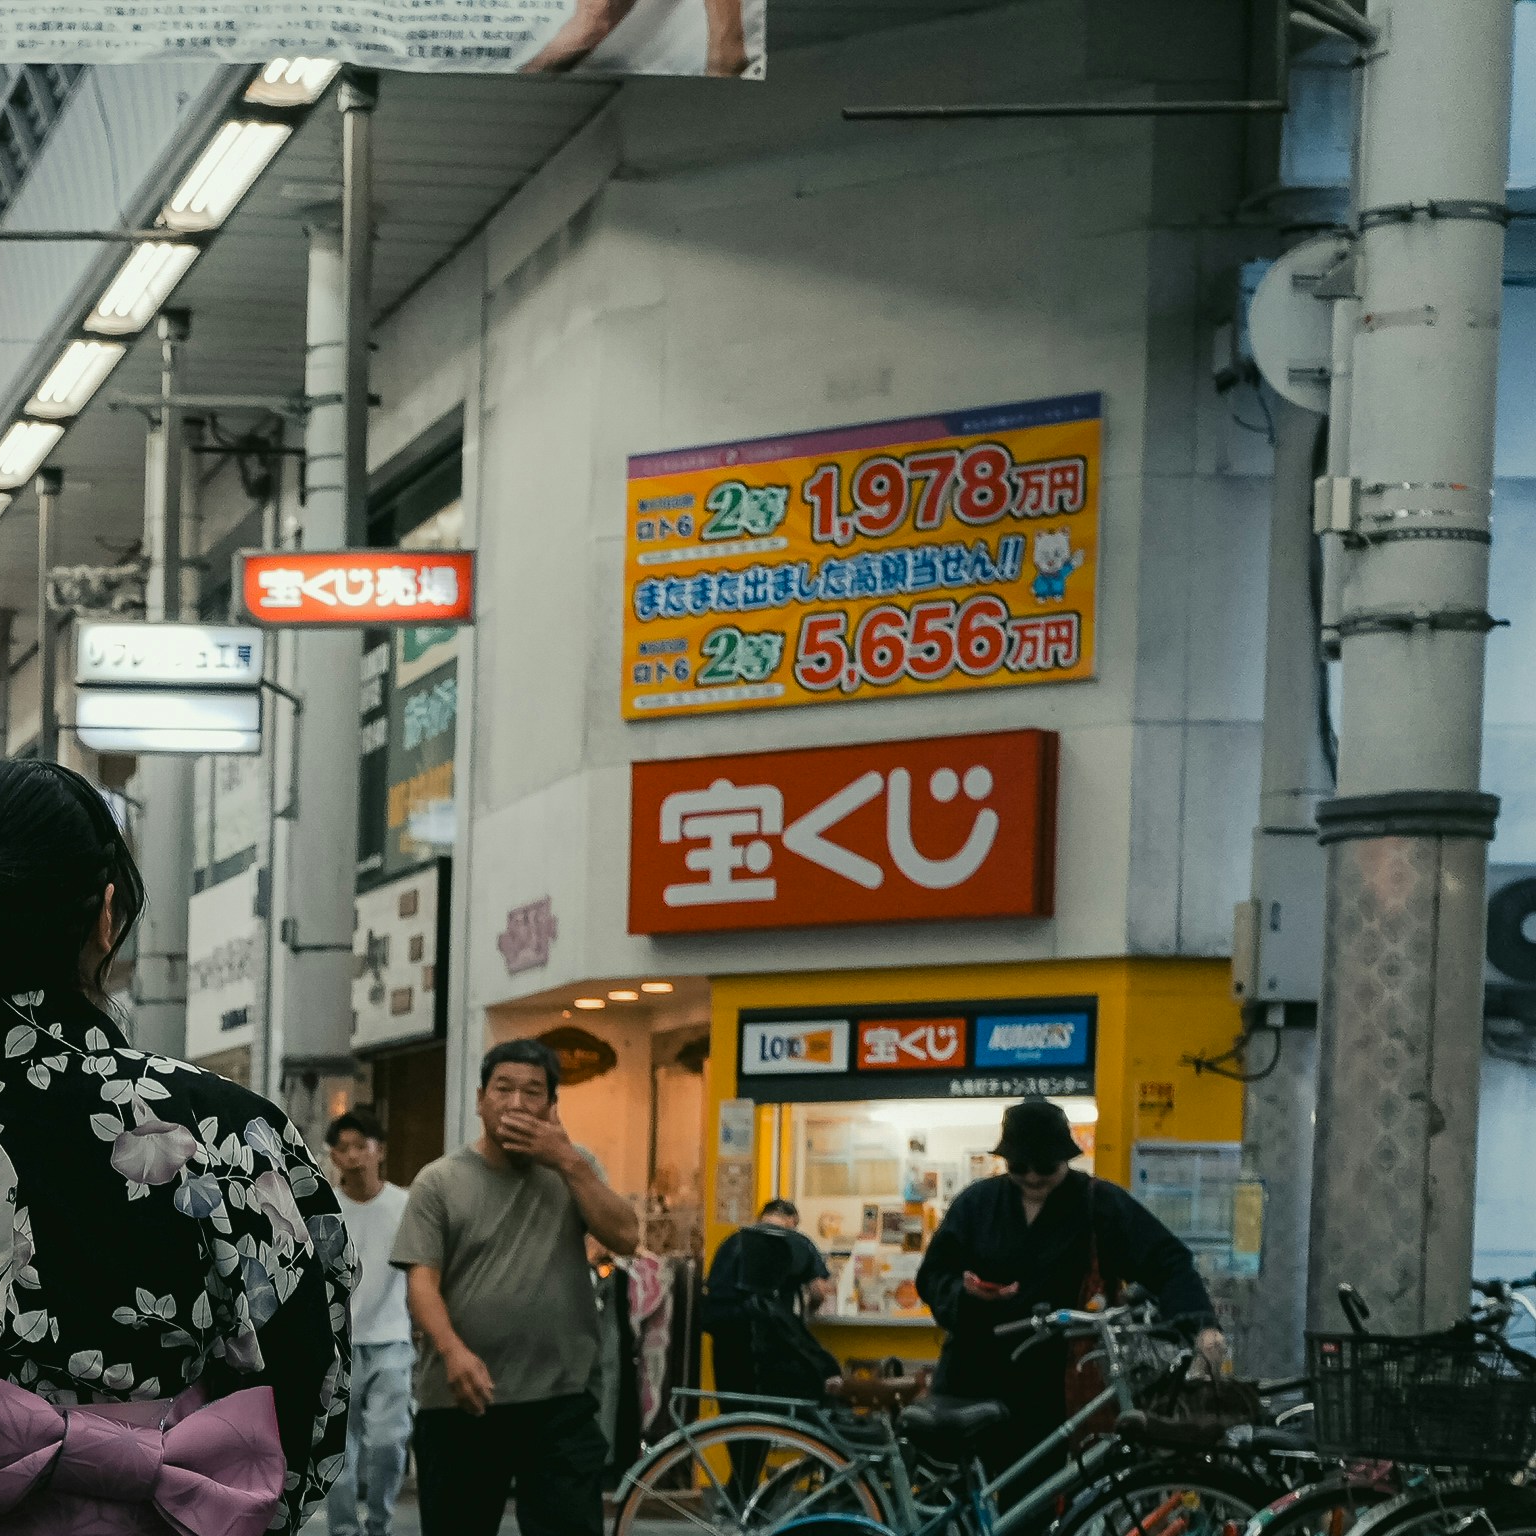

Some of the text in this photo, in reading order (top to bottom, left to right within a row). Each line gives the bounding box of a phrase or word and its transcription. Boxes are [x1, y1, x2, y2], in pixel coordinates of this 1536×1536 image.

[801, 443, 1085, 547] 1,978万円
[258, 566, 458, 608] 宝くじ売場
[794, 594, 1080, 694] 5,656万円
[659, 765, 1000, 909] 宝くじ
[863, 1025, 959, 1064] 宝くじ
